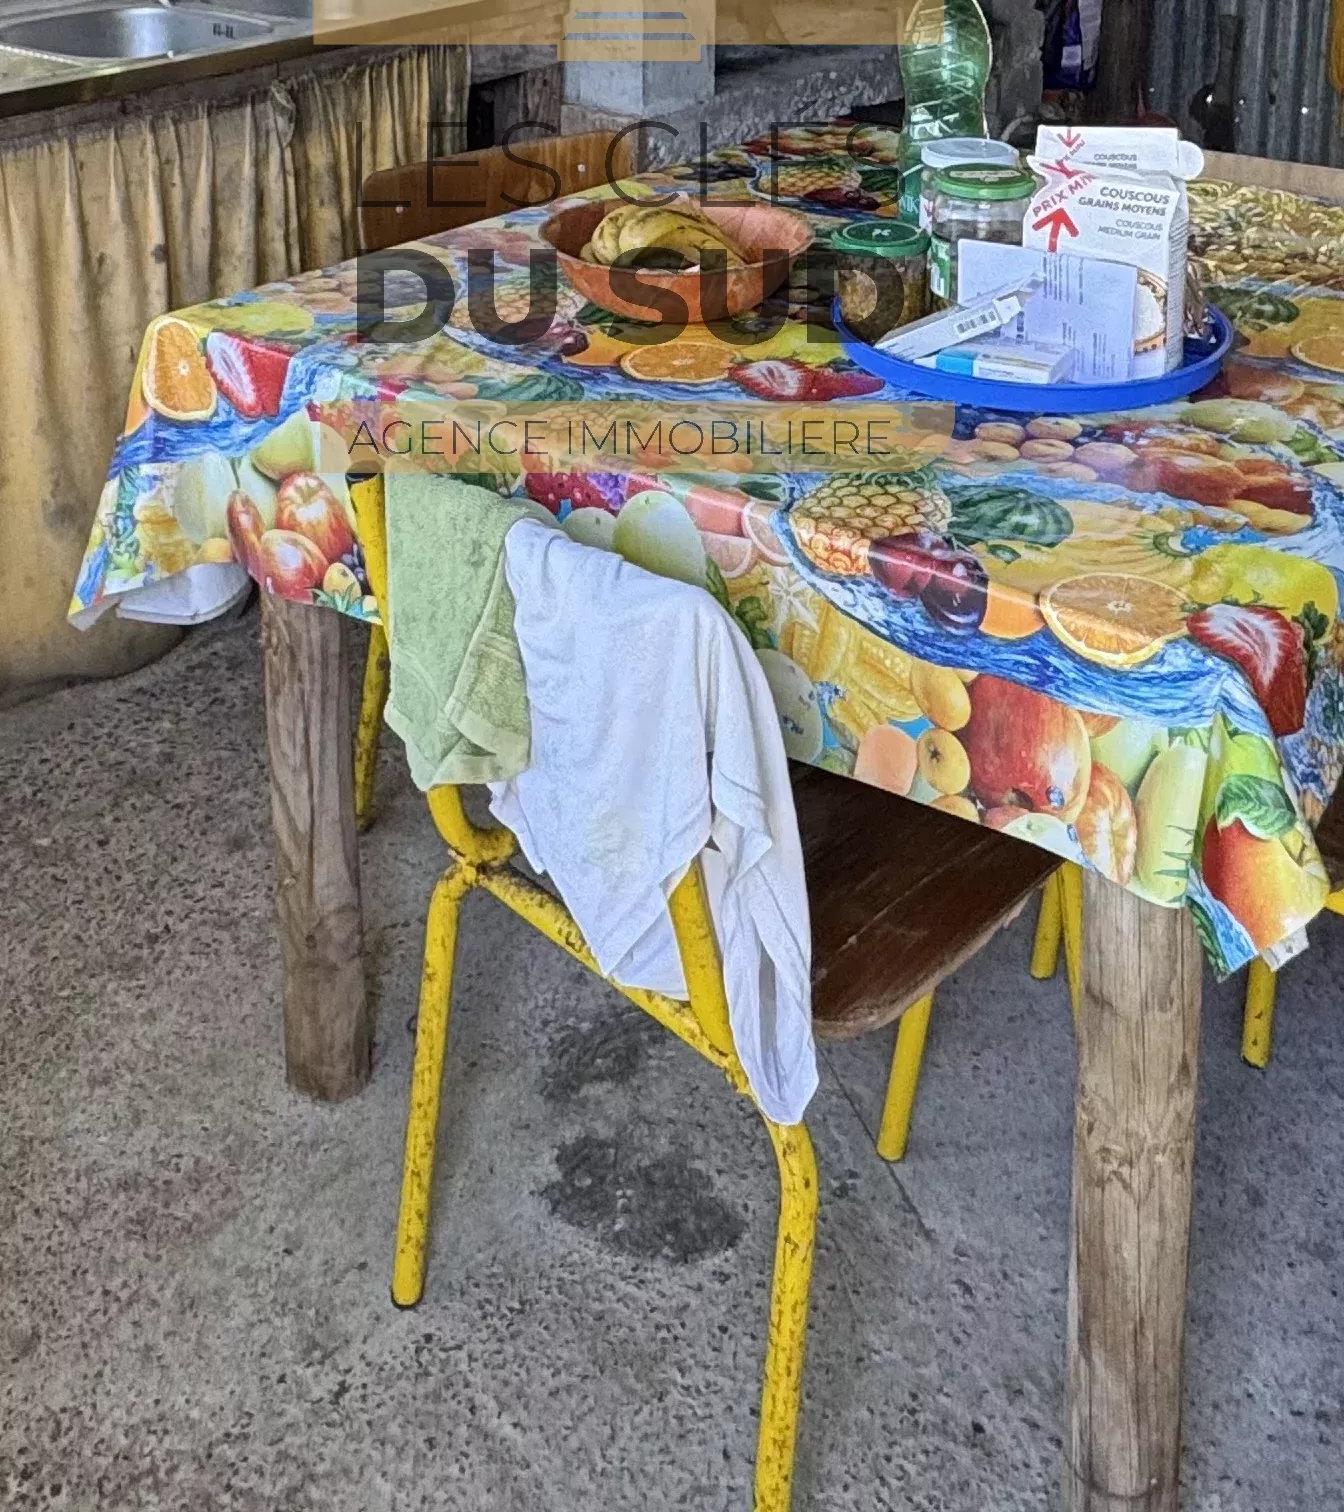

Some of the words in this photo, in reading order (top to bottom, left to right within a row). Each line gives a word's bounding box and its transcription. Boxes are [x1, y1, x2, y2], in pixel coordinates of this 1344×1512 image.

[1032, 190, 1069, 217] PRIX
[1100, 187, 1170, 205] COUSCOUS
[1078, 196, 1120, 212] GRAINS
[1121, 203, 1167, 217] MOYENS
[1097, 225, 1133, 238] MEDIUM
[1134, 230, 1161, 240] GRAIN
[1115, 219, 1163, 232] COUSCOUS
